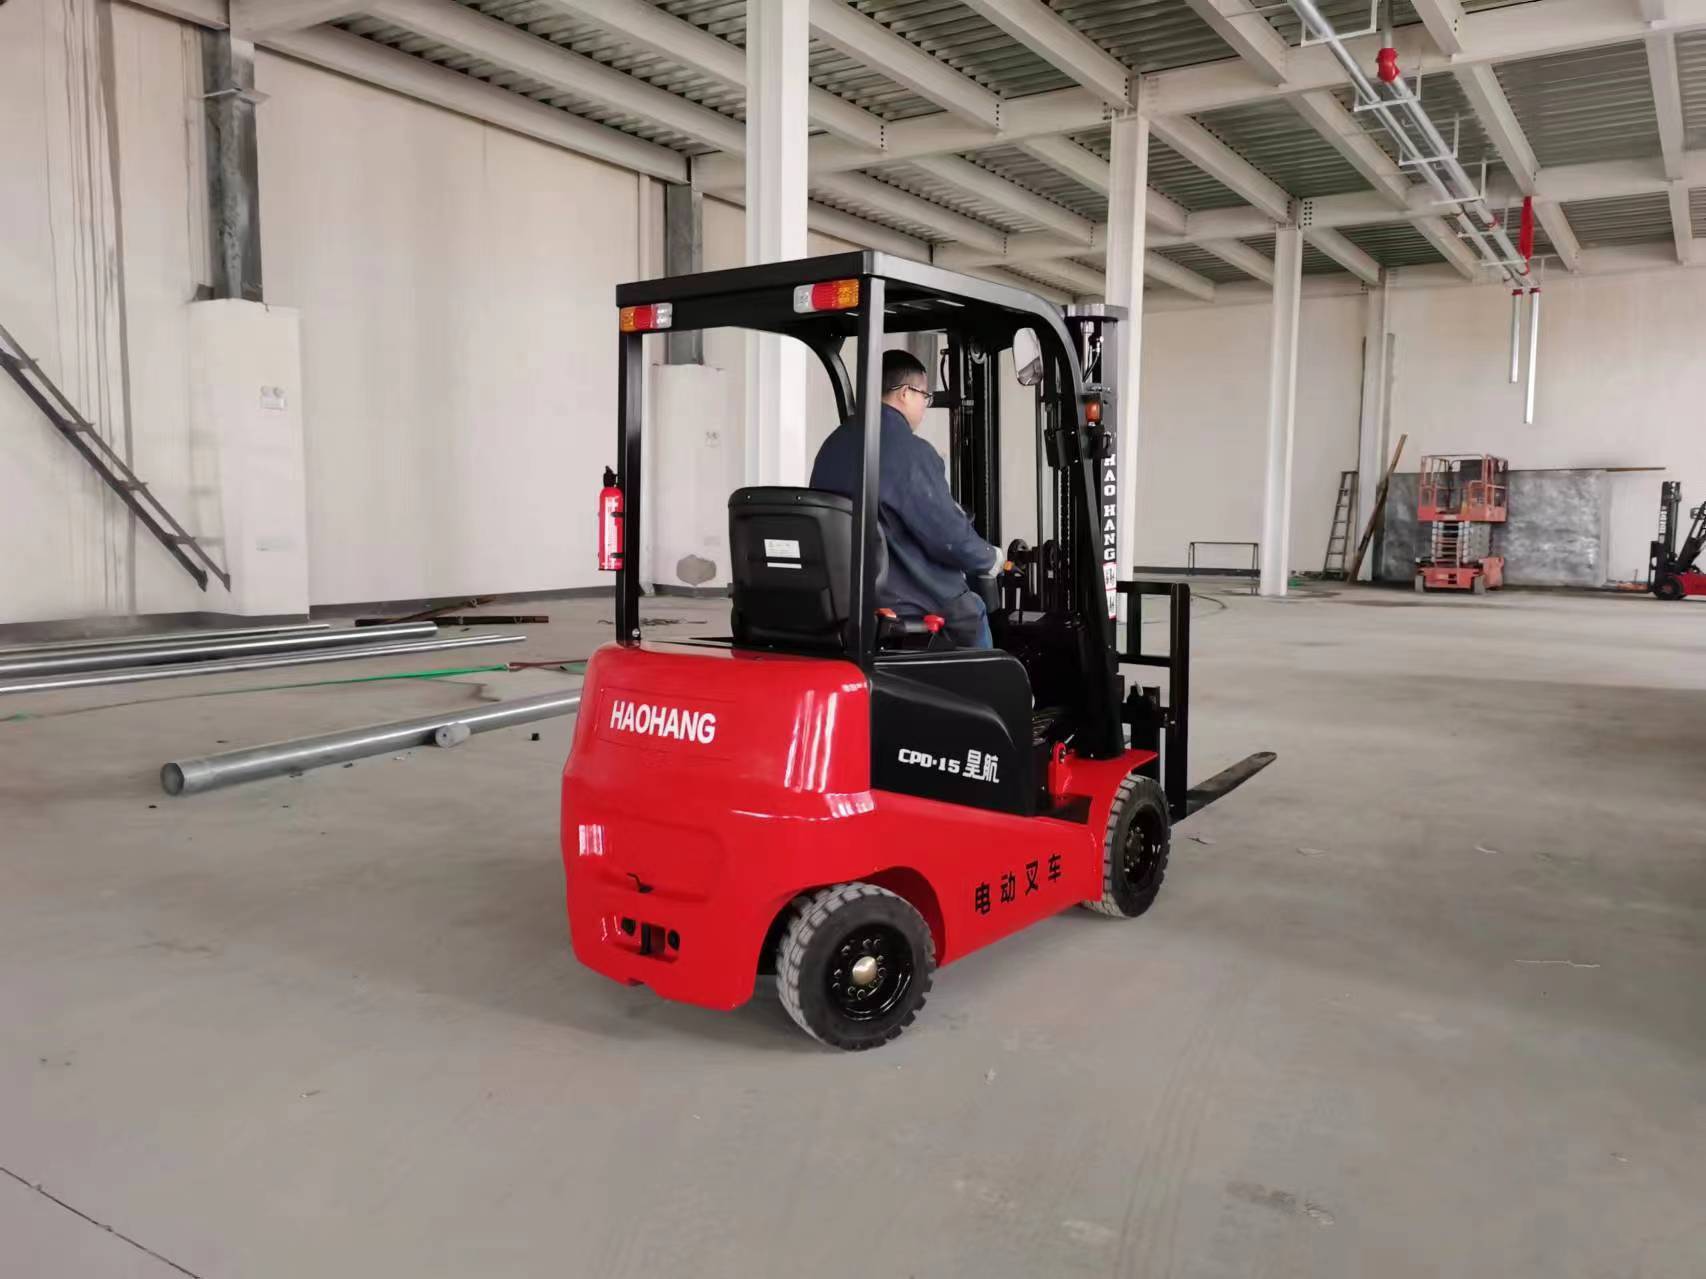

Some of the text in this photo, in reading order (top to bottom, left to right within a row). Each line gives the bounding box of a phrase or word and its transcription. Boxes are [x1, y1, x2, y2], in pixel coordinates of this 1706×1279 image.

[1103, 454, 1117, 497] HAO
[1103, 504, 1117, 561] HANG
[609, 700, 717, 744] HAOHANG
[975, 853, 1062, 916] 电动叉车
